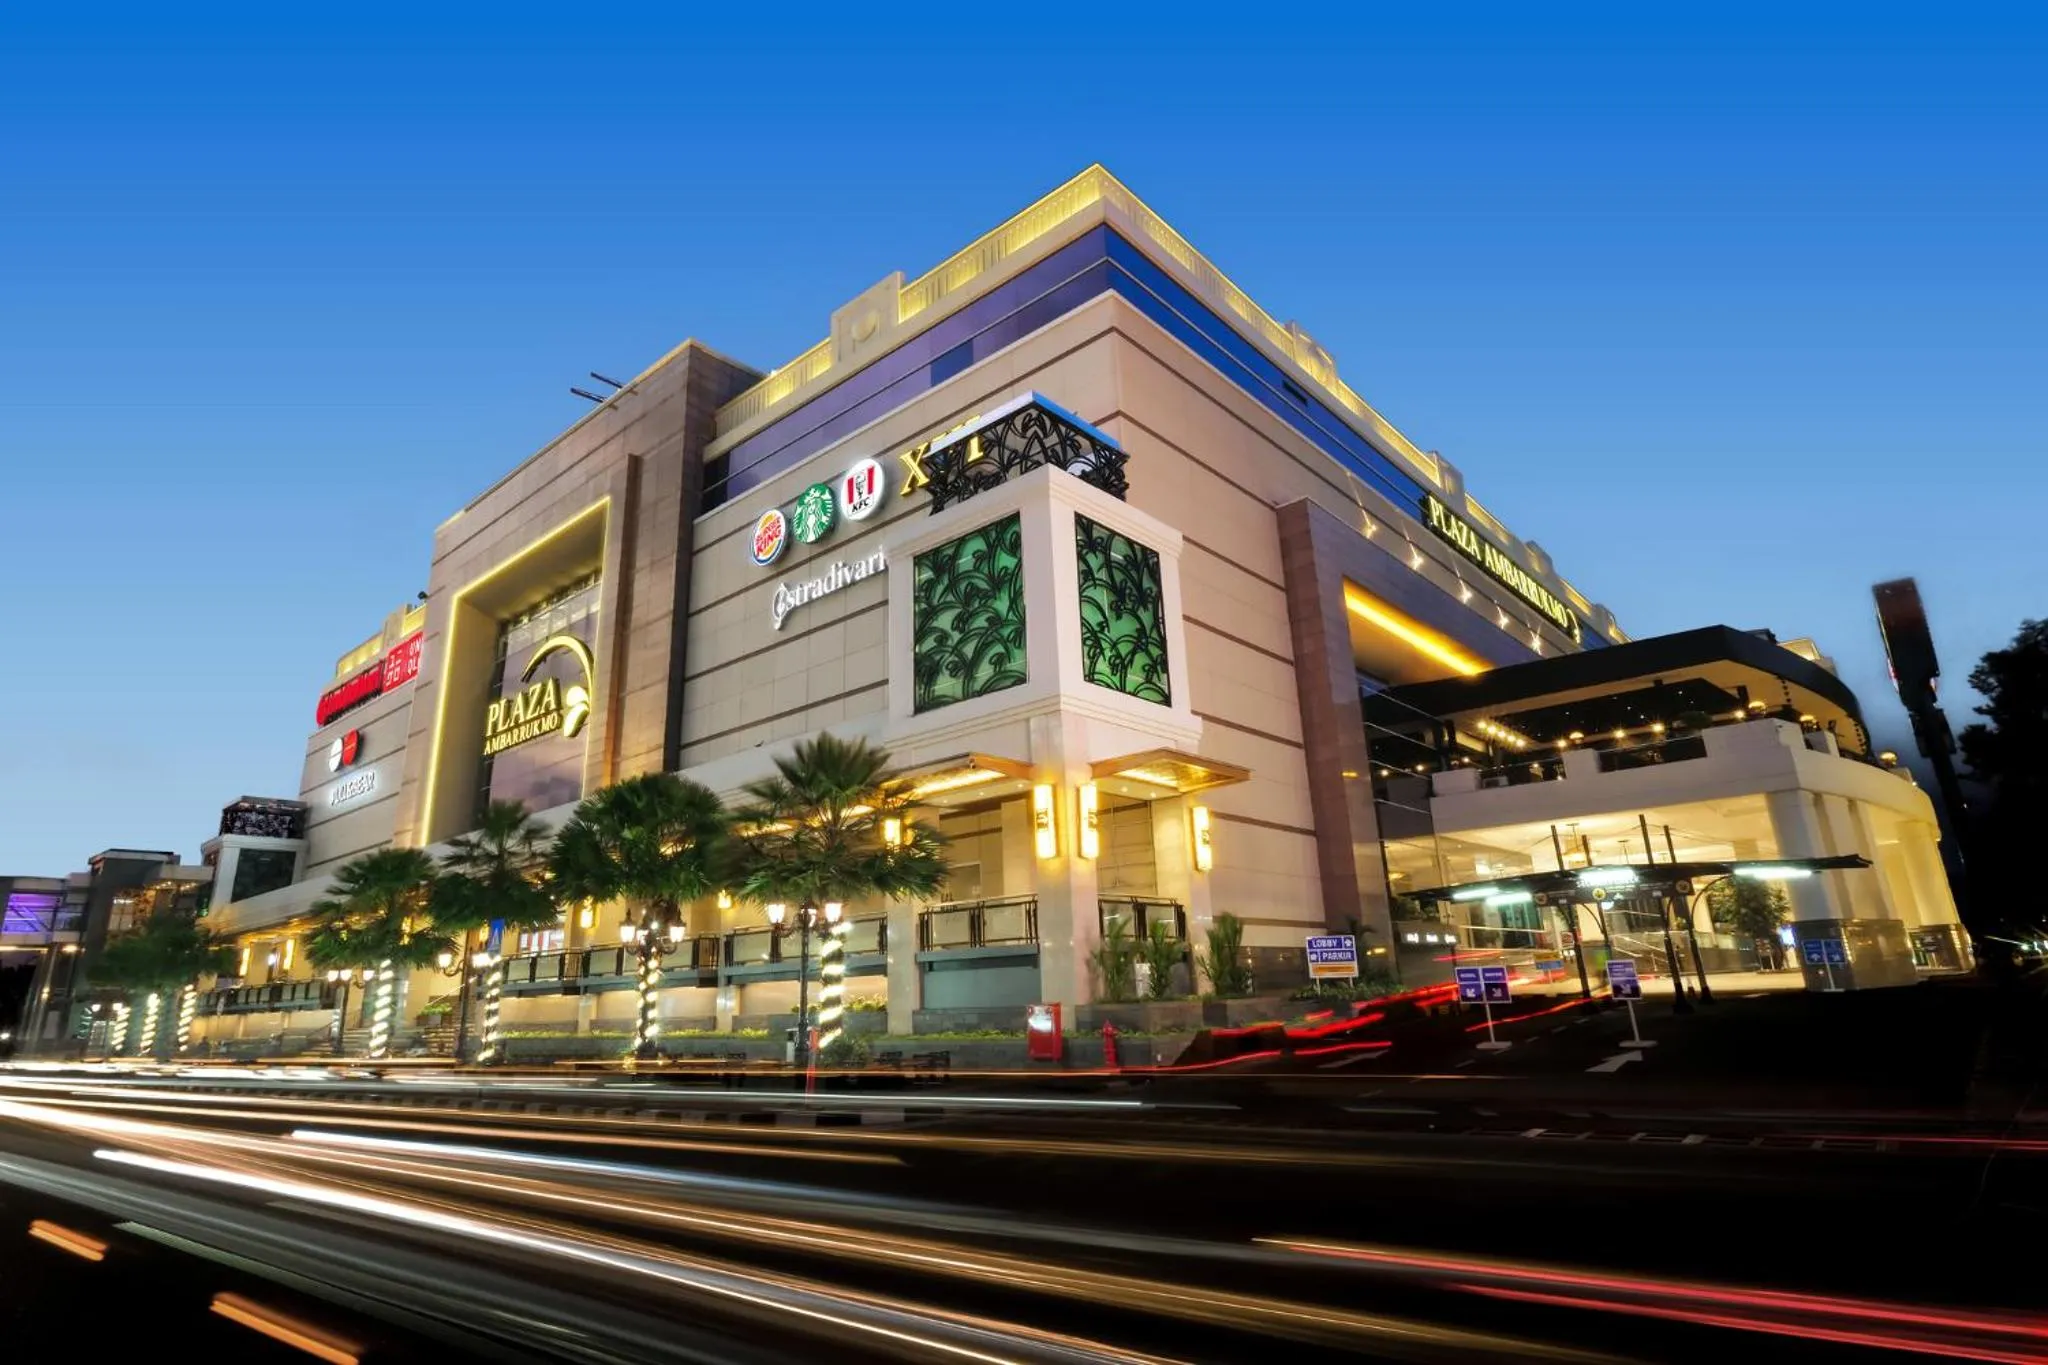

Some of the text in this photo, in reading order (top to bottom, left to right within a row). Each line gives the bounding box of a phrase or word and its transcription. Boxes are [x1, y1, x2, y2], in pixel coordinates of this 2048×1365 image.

[899, 413, 984, 495] XI
[852, 496, 870, 512] KFC
[756, 526, 782, 557] KING
[1428, 495, 1568, 628] PLAZA AMBARRUKMO
[486, 678, 558, 737] PLAZA
[483, 713, 559, 756] AMBARRUKMO
[1311, 938, 1338, 948] LOBBY
